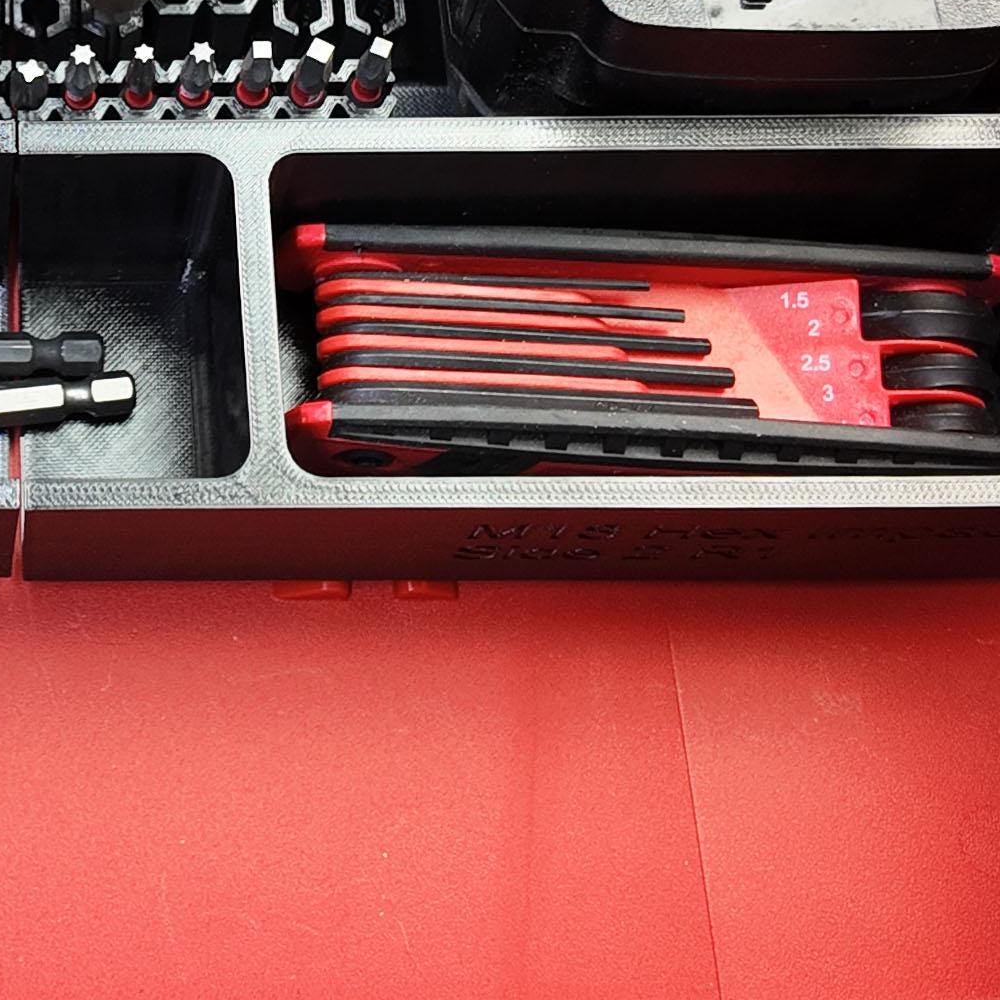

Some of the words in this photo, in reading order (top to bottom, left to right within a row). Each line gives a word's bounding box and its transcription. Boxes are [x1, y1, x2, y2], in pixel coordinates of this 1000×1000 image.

[780, 291, 809, 309] 1.5
[807, 318, 821, 337] 2
[800, 353, 831, 372] 2.5
[821, 383, 835, 402] 3
